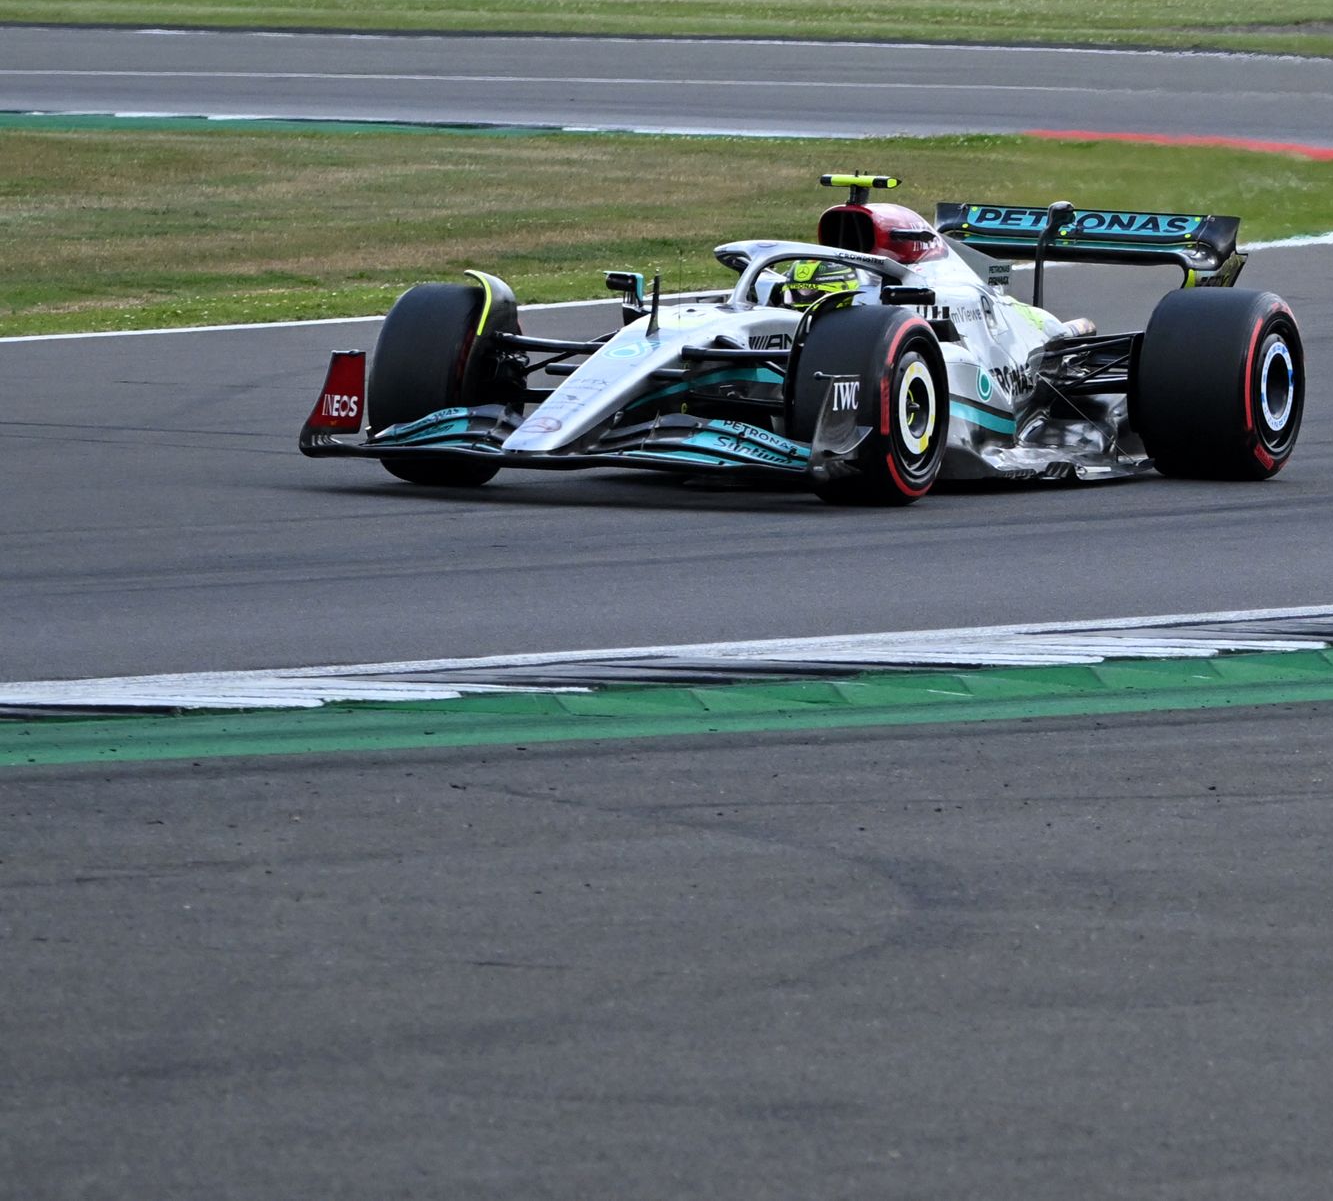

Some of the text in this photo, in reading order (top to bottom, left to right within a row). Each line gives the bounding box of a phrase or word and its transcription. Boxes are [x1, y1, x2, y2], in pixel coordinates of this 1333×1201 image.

[975, 208, 1191, 234] PETONAS
[321, 394, 359, 418] INEOS
[832, 381, 860, 412] IWC
[722, 419, 800, 453] PETRONAS
